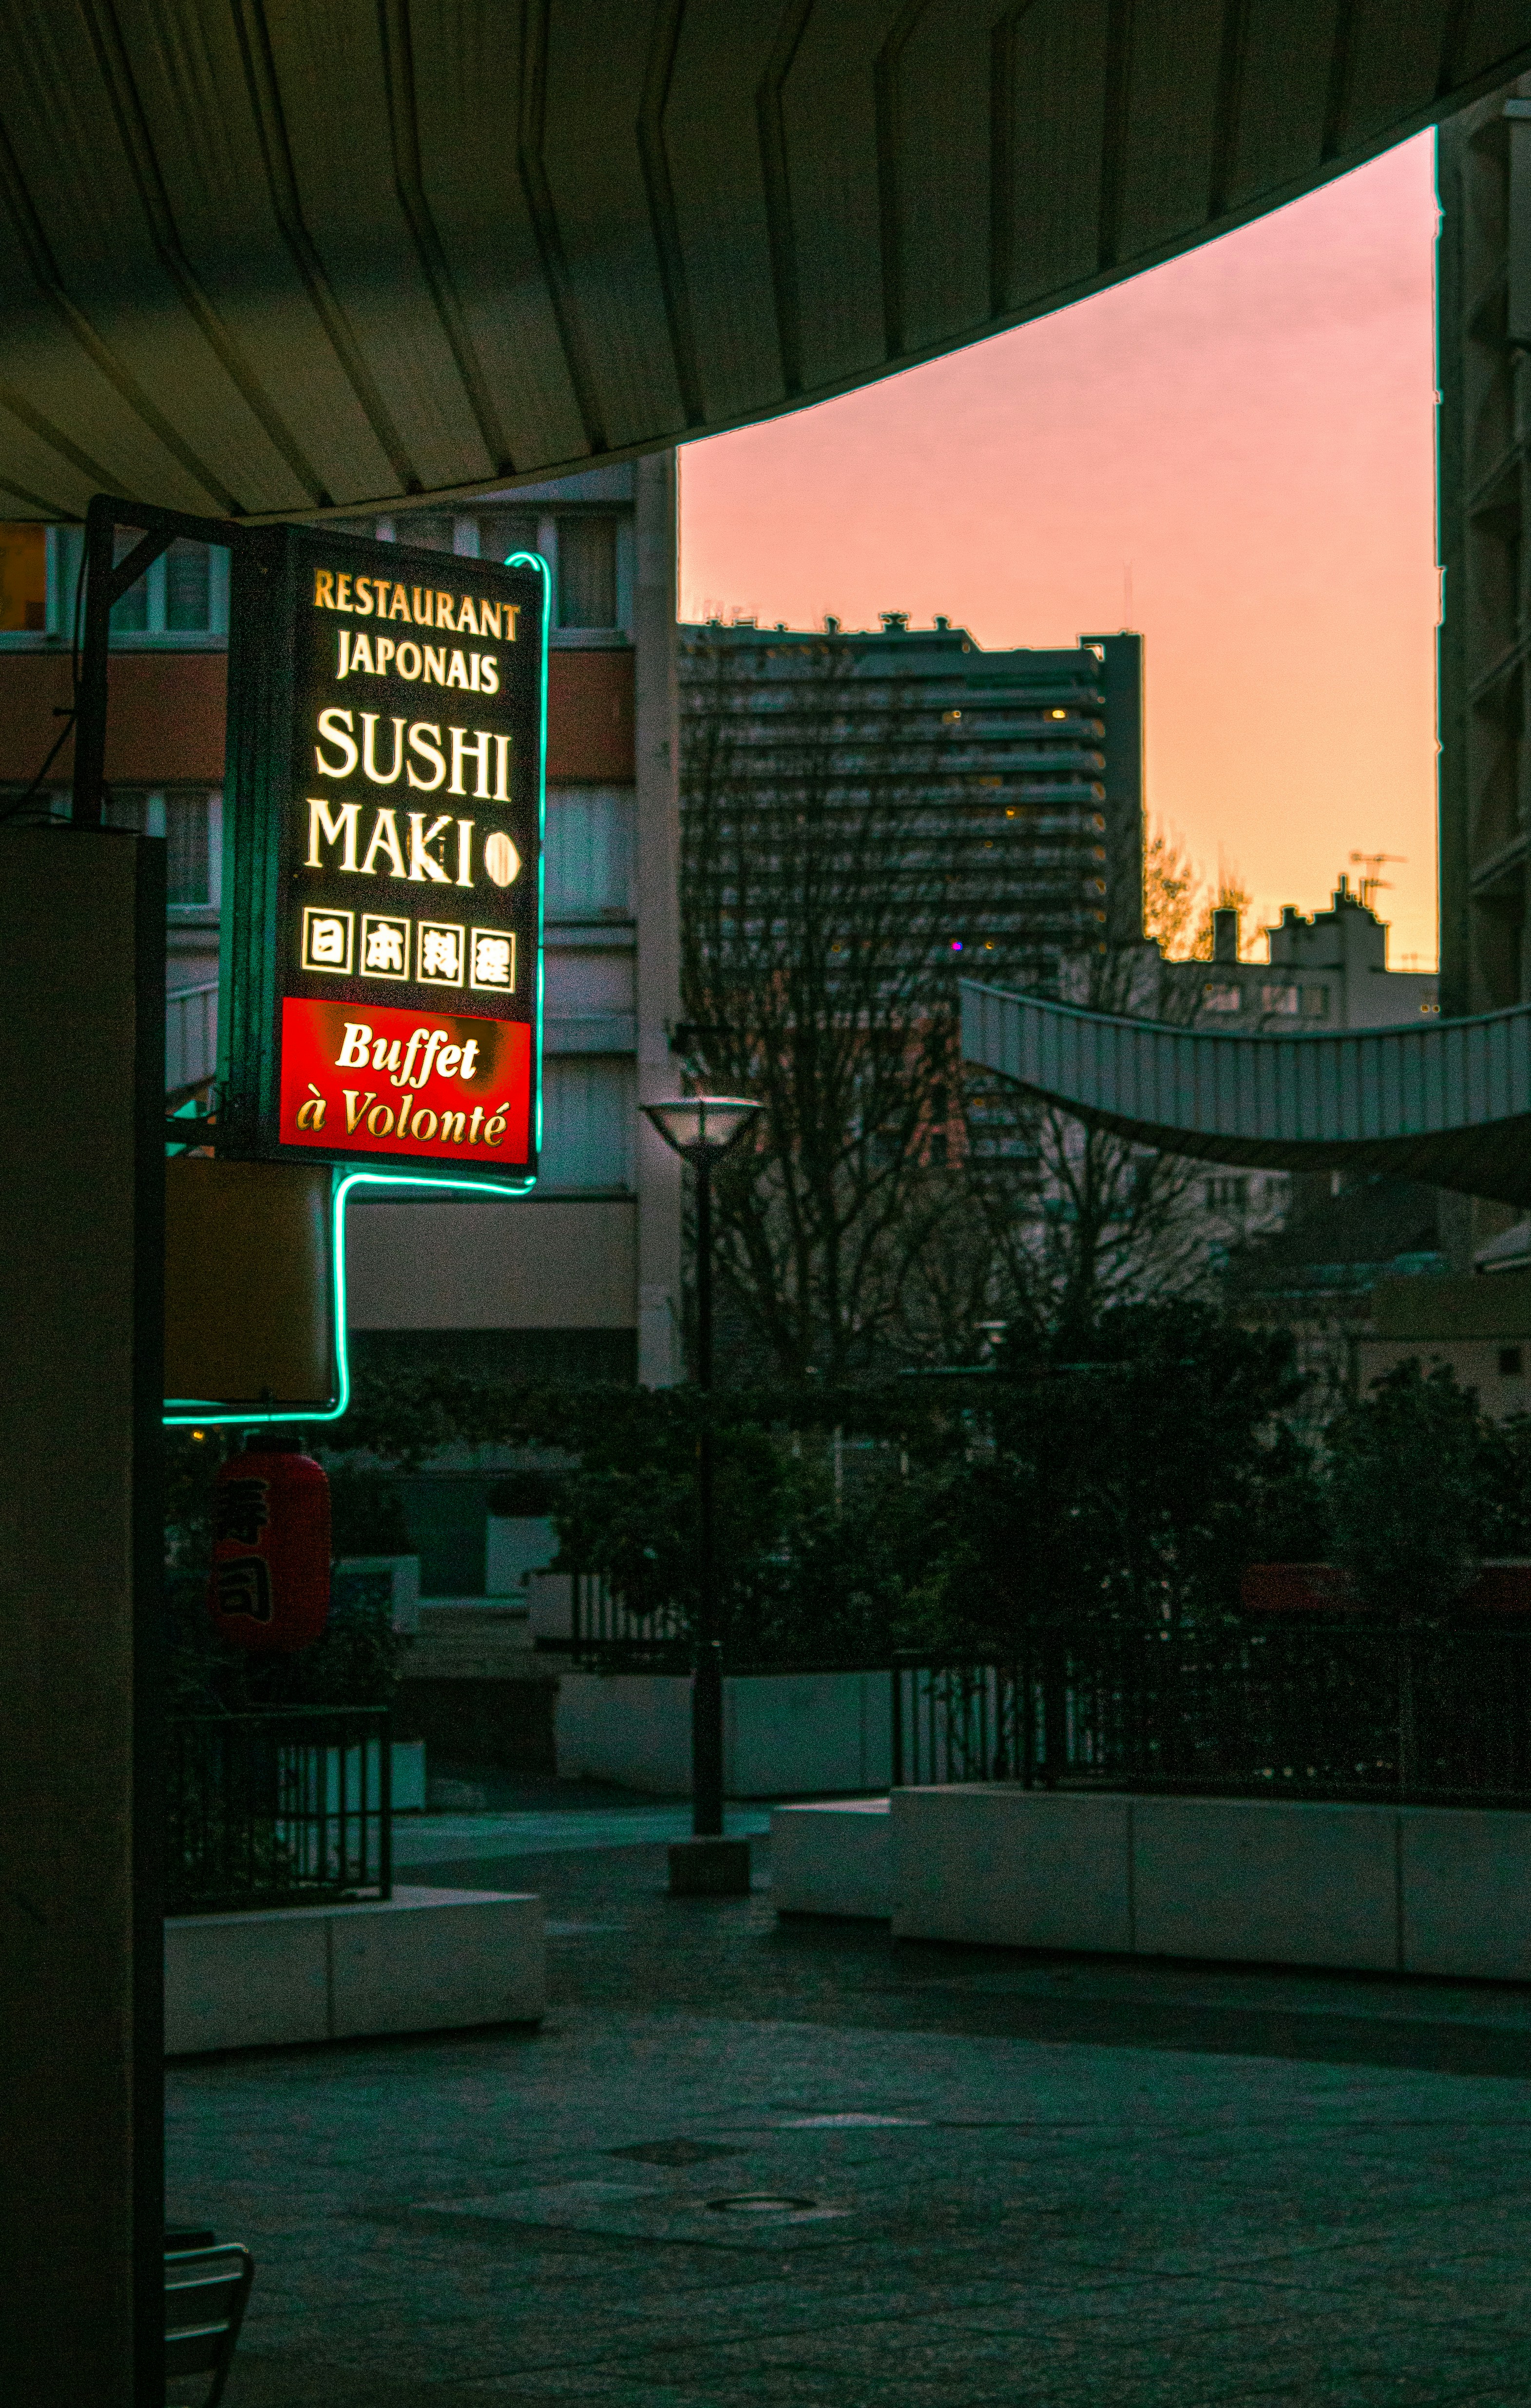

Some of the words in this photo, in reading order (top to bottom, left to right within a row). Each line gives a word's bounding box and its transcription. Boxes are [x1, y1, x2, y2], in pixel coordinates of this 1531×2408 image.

[314, 568, 521, 641] RESTAURANT
[336, 629, 499, 694] JAPONAIS
[315, 707, 512, 802] SUSHI
[304, 797, 475, 888] MAKI
[311, 918, 510, 983] 日本料理
[335, 1021, 479, 1089] Buffet
[295, 1083, 327, 1132] à
[342, 1089, 511, 1147] Volonté
